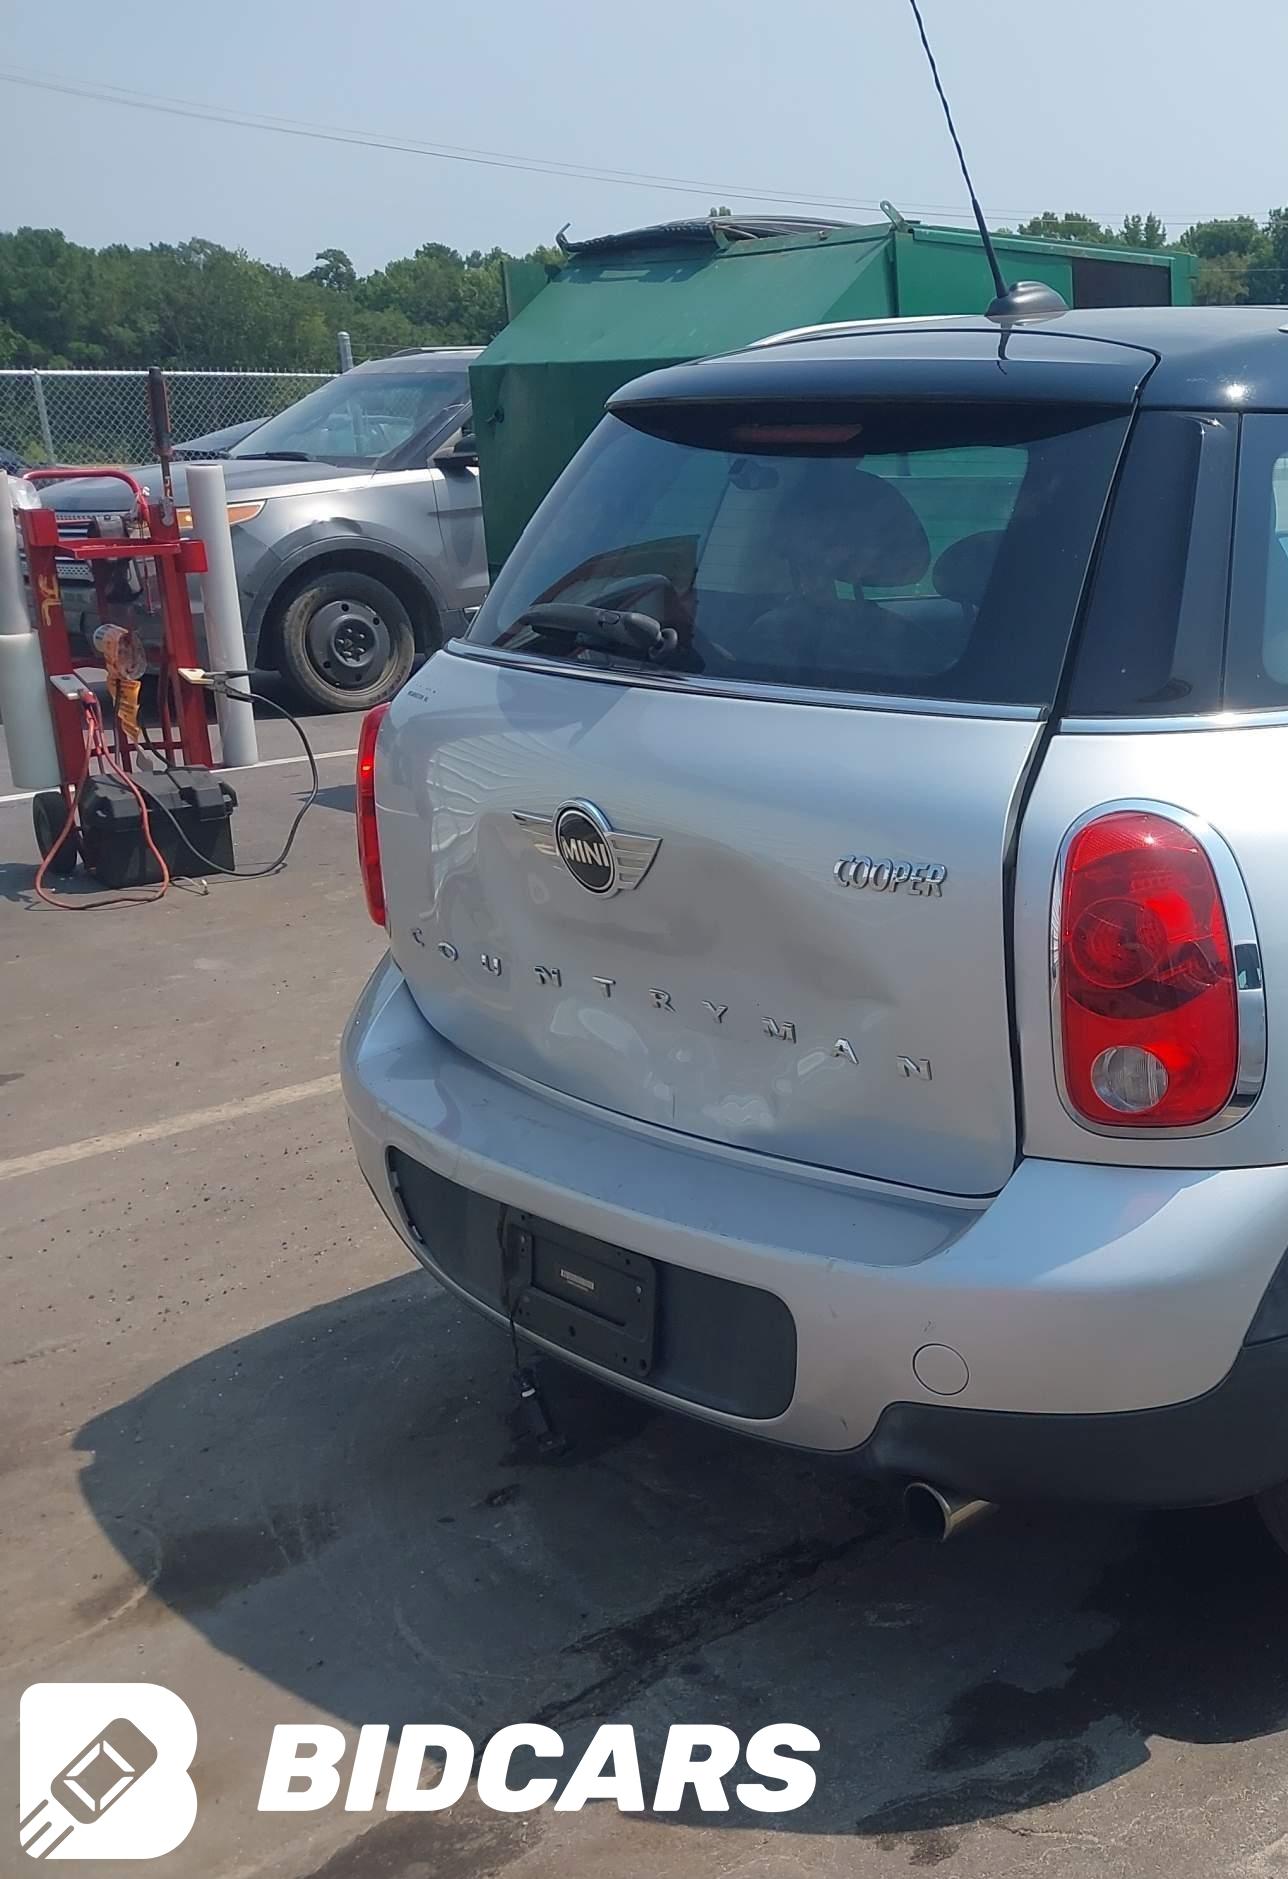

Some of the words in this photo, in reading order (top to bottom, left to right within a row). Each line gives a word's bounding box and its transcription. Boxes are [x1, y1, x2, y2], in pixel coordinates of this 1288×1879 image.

[560, 836, 610, 867] MINI
[833, 855, 948, 897] COOPER
[411, 927, 933, 1081] COUNTRYMAN
